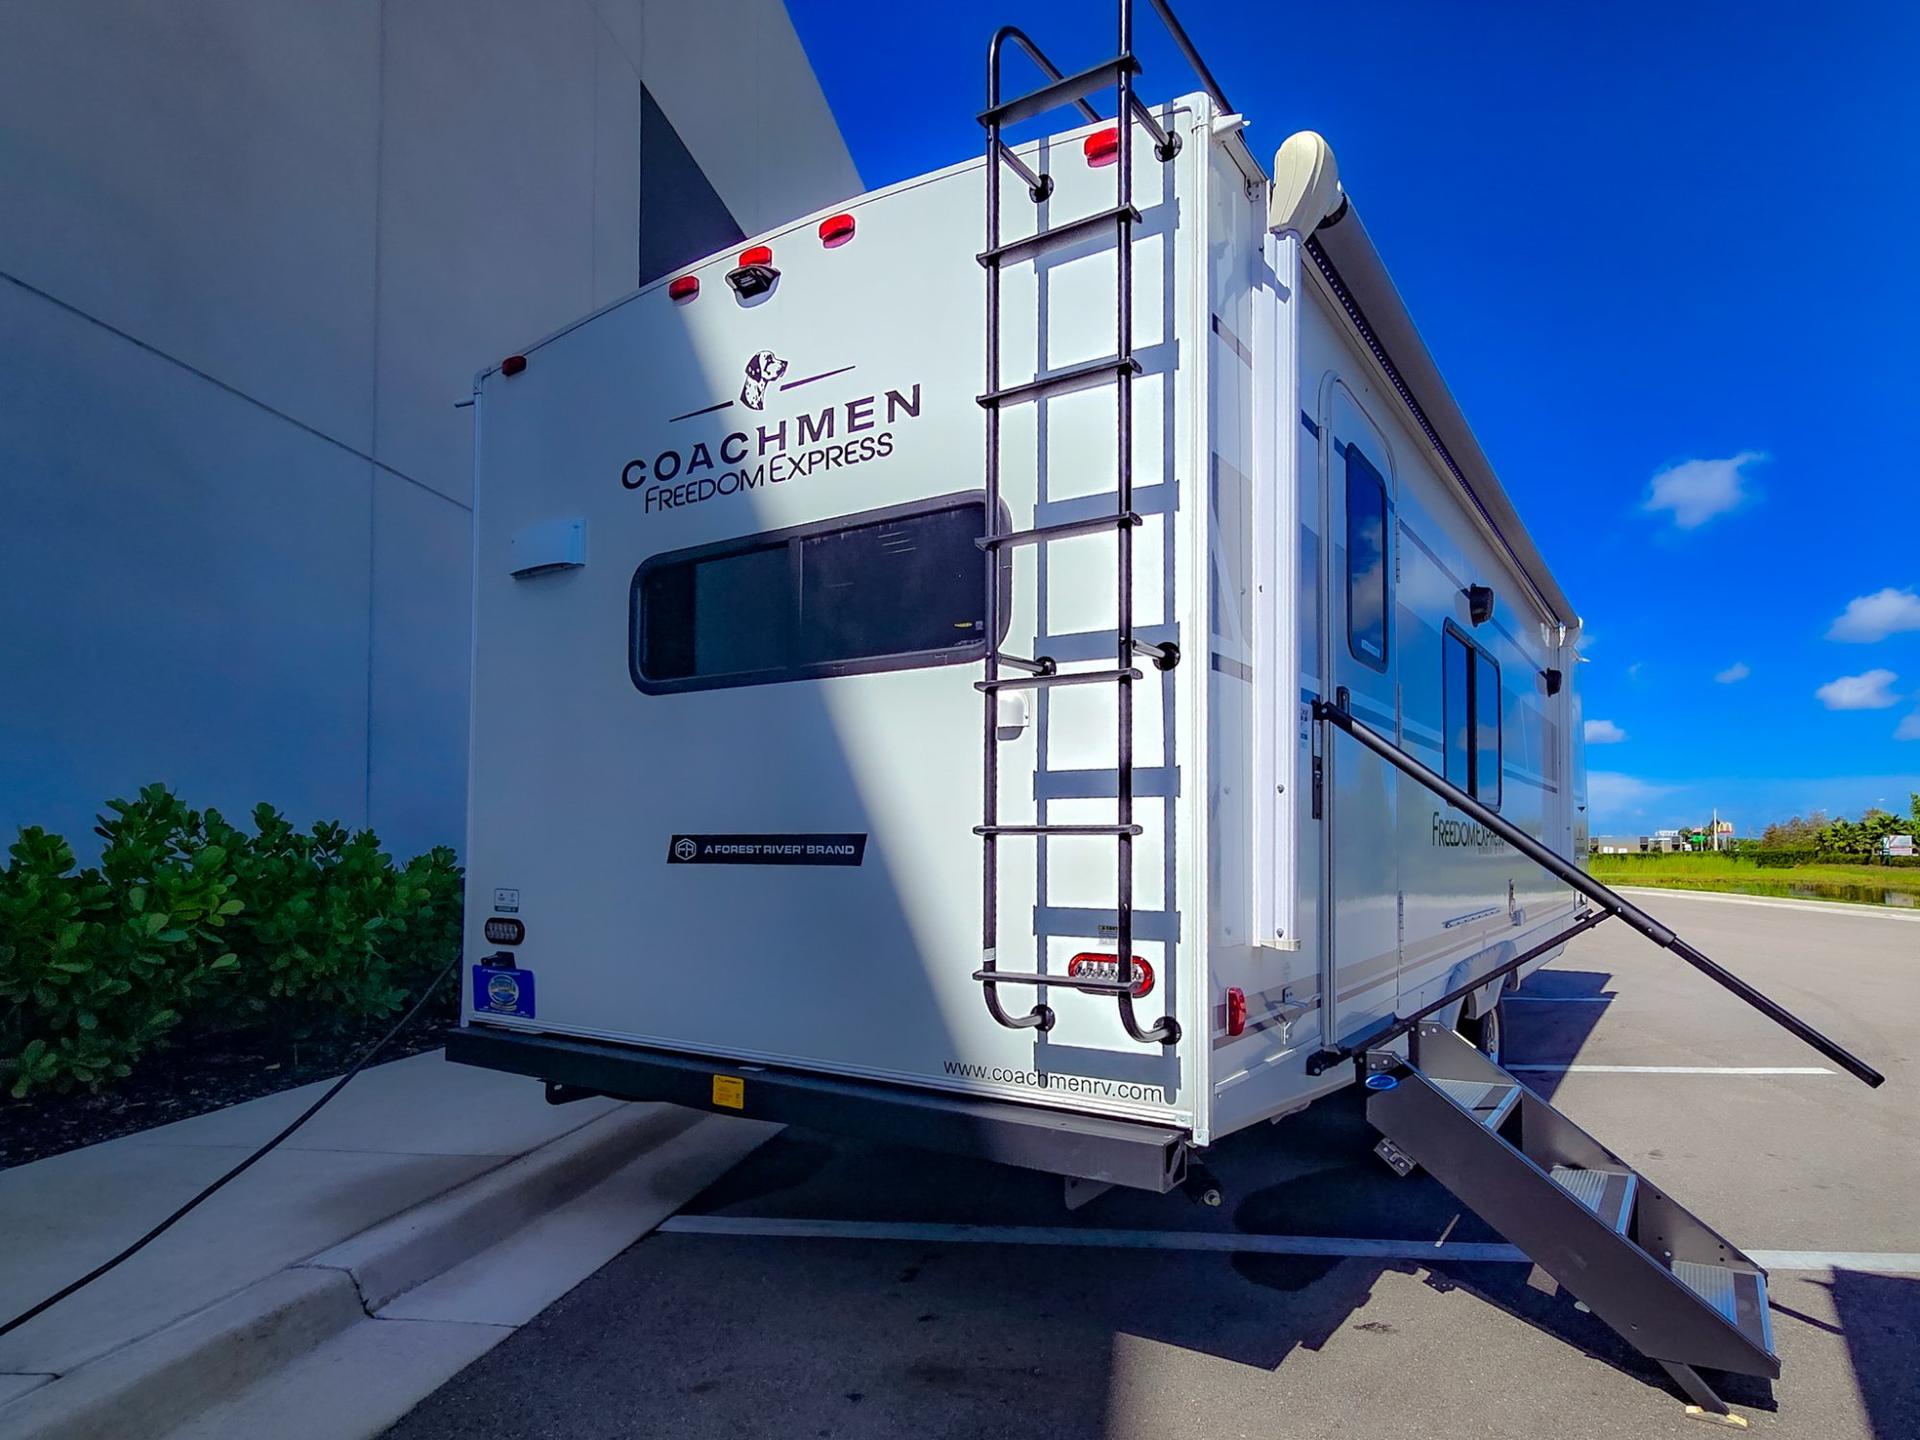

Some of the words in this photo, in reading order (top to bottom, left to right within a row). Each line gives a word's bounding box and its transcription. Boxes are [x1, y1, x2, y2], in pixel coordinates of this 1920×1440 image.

[621, 383, 921, 490] COACHMEN
[704, 845, 713, 854] A
[716, 845, 761, 854] FOREST
[806, 845, 855, 855] BRAND
[944, 1060, 1163, 1103] www.coachmenrv.com
